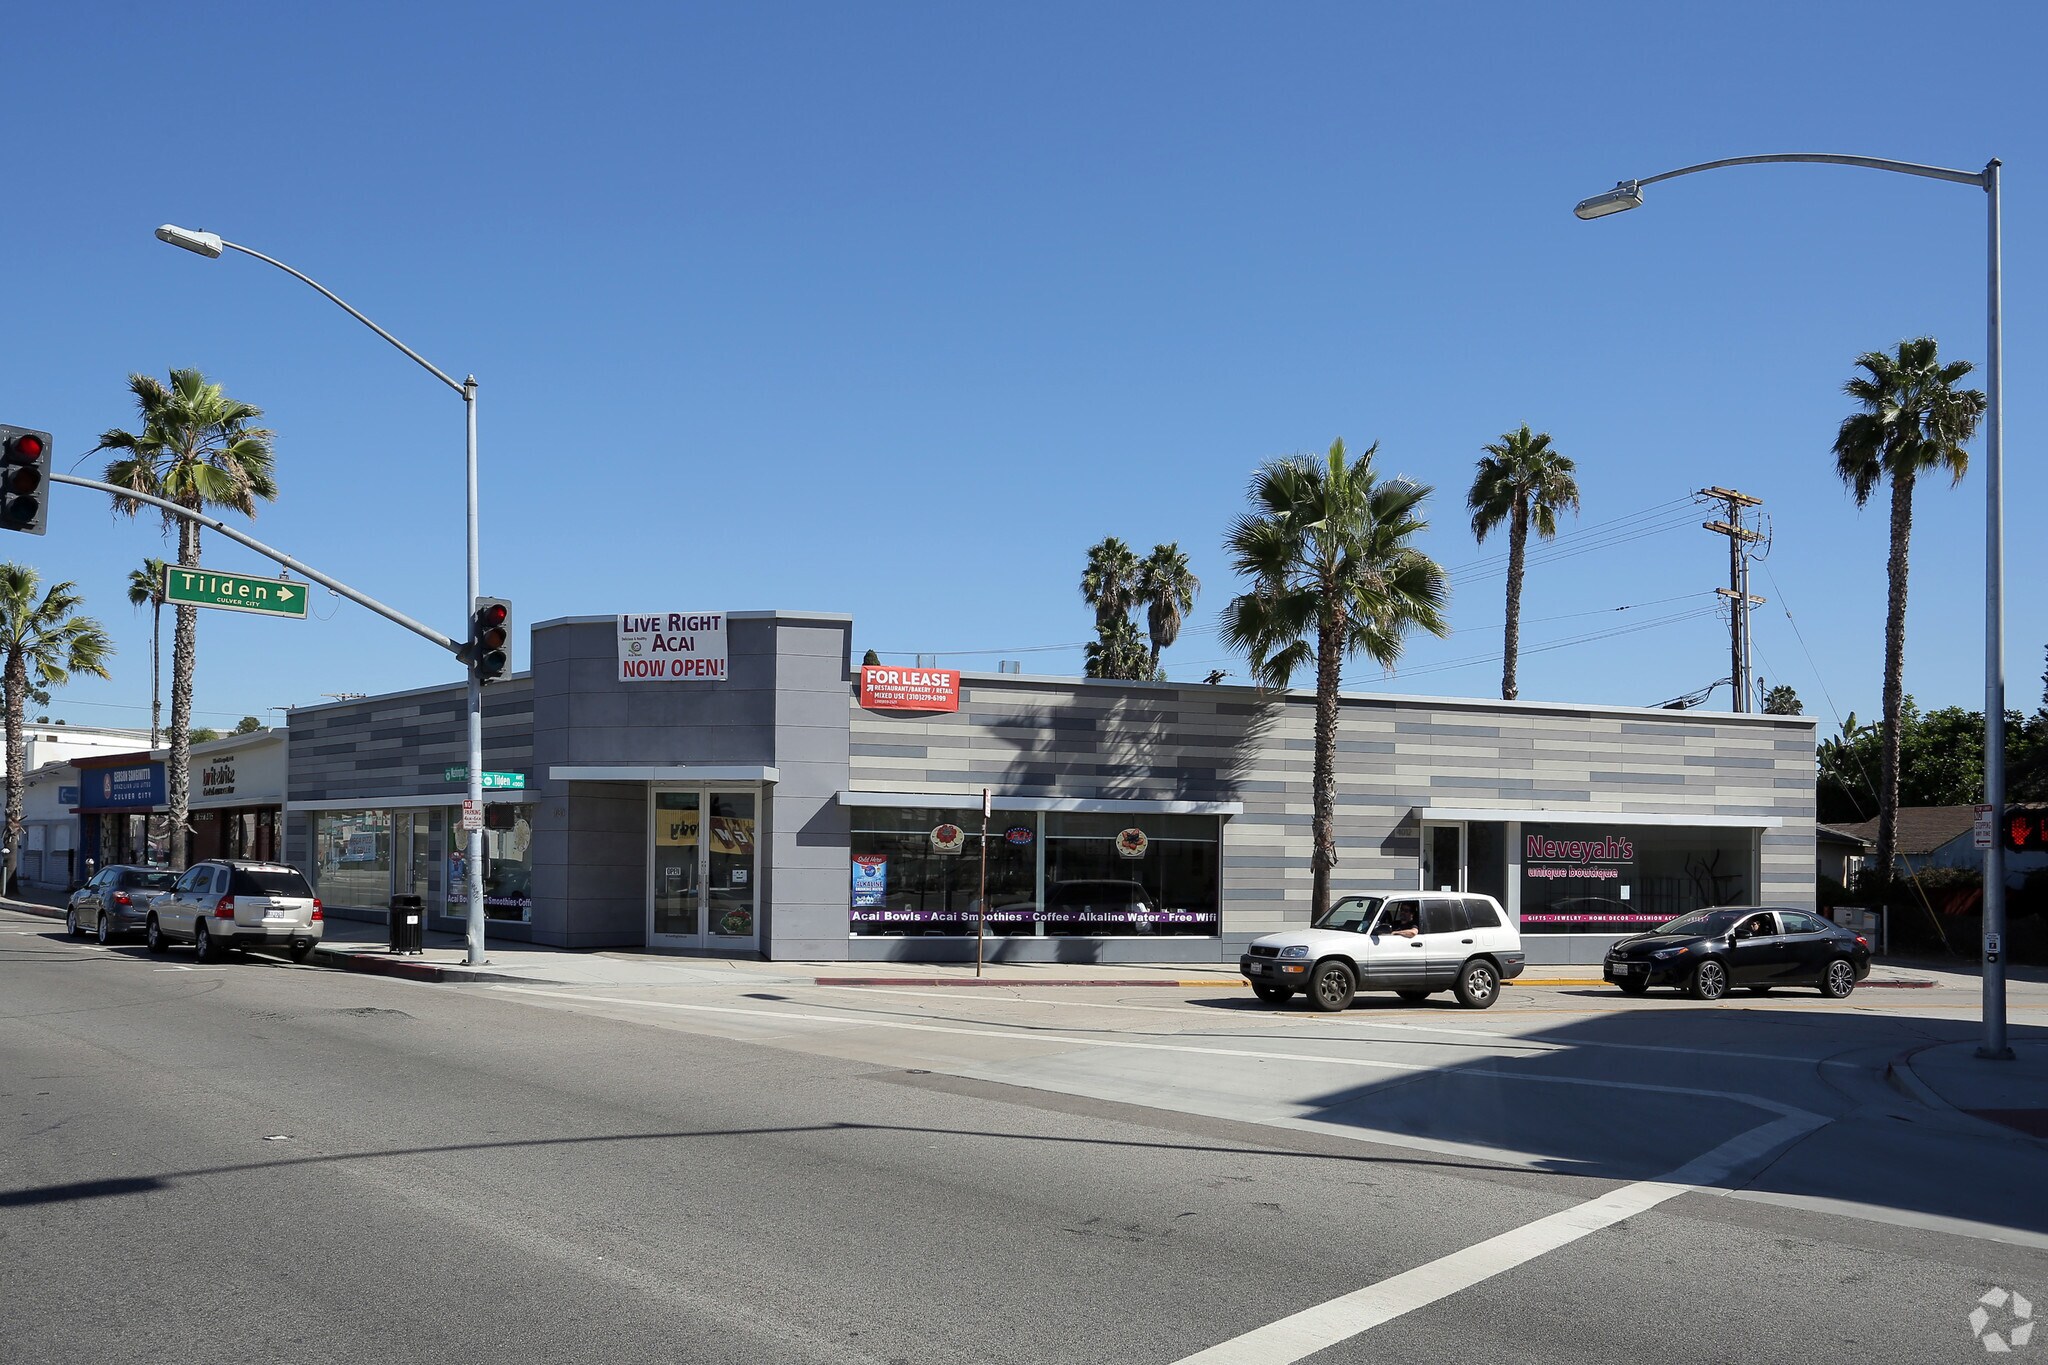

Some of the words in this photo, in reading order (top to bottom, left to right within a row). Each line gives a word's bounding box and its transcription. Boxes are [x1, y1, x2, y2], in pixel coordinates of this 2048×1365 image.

[182, 573, 267, 600] Tilden
[216, 597, 242, 605] CULVER
[623, 615, 660, 633] LIVE
[668, 613, 722, 632] RIGHT
[651, 633, 695, 652] ACAI
[623, 659, 666, 678] NOW
[671, 658, 725, 677] OPEN!
[866, 669, 899, 685] FOR
[902, 671, 950, 687] LEASE
[874, 685, 931, 694] RESTAURANT/BAKERY
[936, 687, 954, 695] RETAIL
[893, 692, 905, 700] USE
[494, 774, 511, 786] Tilden
[113, 792, 135, 800] CULVER
[137, 791, 152, 799] CITY
[1975, 821, 1992, 830] STOPPING
[1527, 834, 1633, 865] Neveyah's
[666, 867, 680, 875] OPEN
[1527, 865, 1567, 880] unique
[1568, 865, 1618, 881] boutique
[448, 894, 459, 903] Acai
[488, 896, 517, 906] Smoothies
[852, 911, 880, 921] Acai
[884, 911, 921, 921] Bowls
[930, 911, 957, 921] Acai
[960, 911, 1022, 921] Smoothies
[1032, 912, 1069, 922] Coffee
[1078, 912, 1125, 922] Alkaline
[1127, 912, 1160, 922] Water
[1168, 912, 1193, 922] Free
[1195, 912, 1217, 922] Wifi
